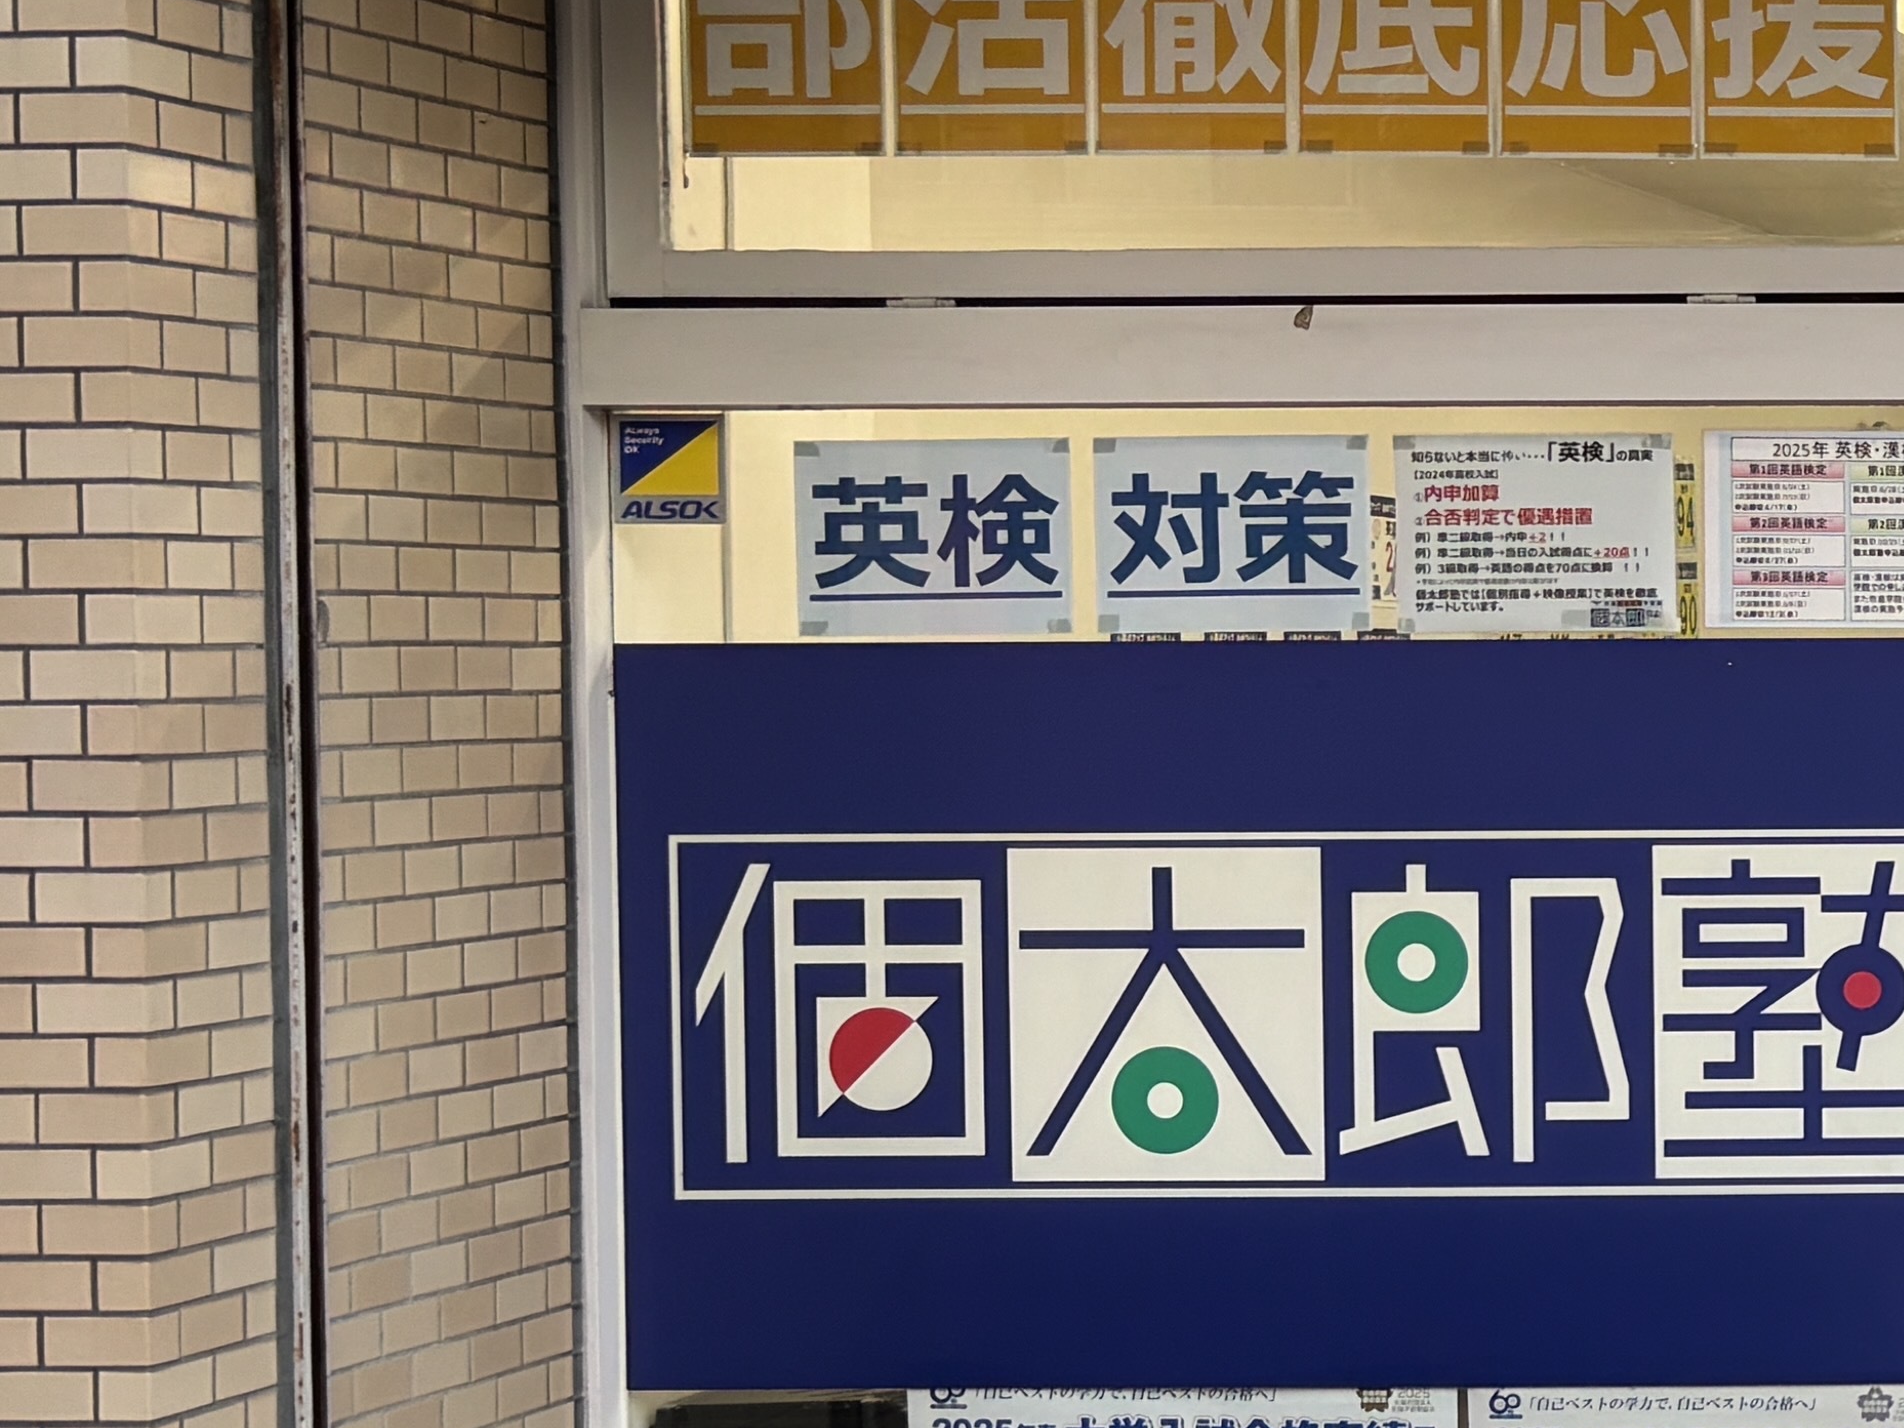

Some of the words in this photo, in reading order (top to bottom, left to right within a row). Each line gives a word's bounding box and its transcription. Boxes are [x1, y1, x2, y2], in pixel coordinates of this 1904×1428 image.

[625, 428, 659, 436] Always
[624, 436, 664, 446] Security
[1772, 441, 1829, 459] 2025年
[621, 500, 719, 520] ALSOK
